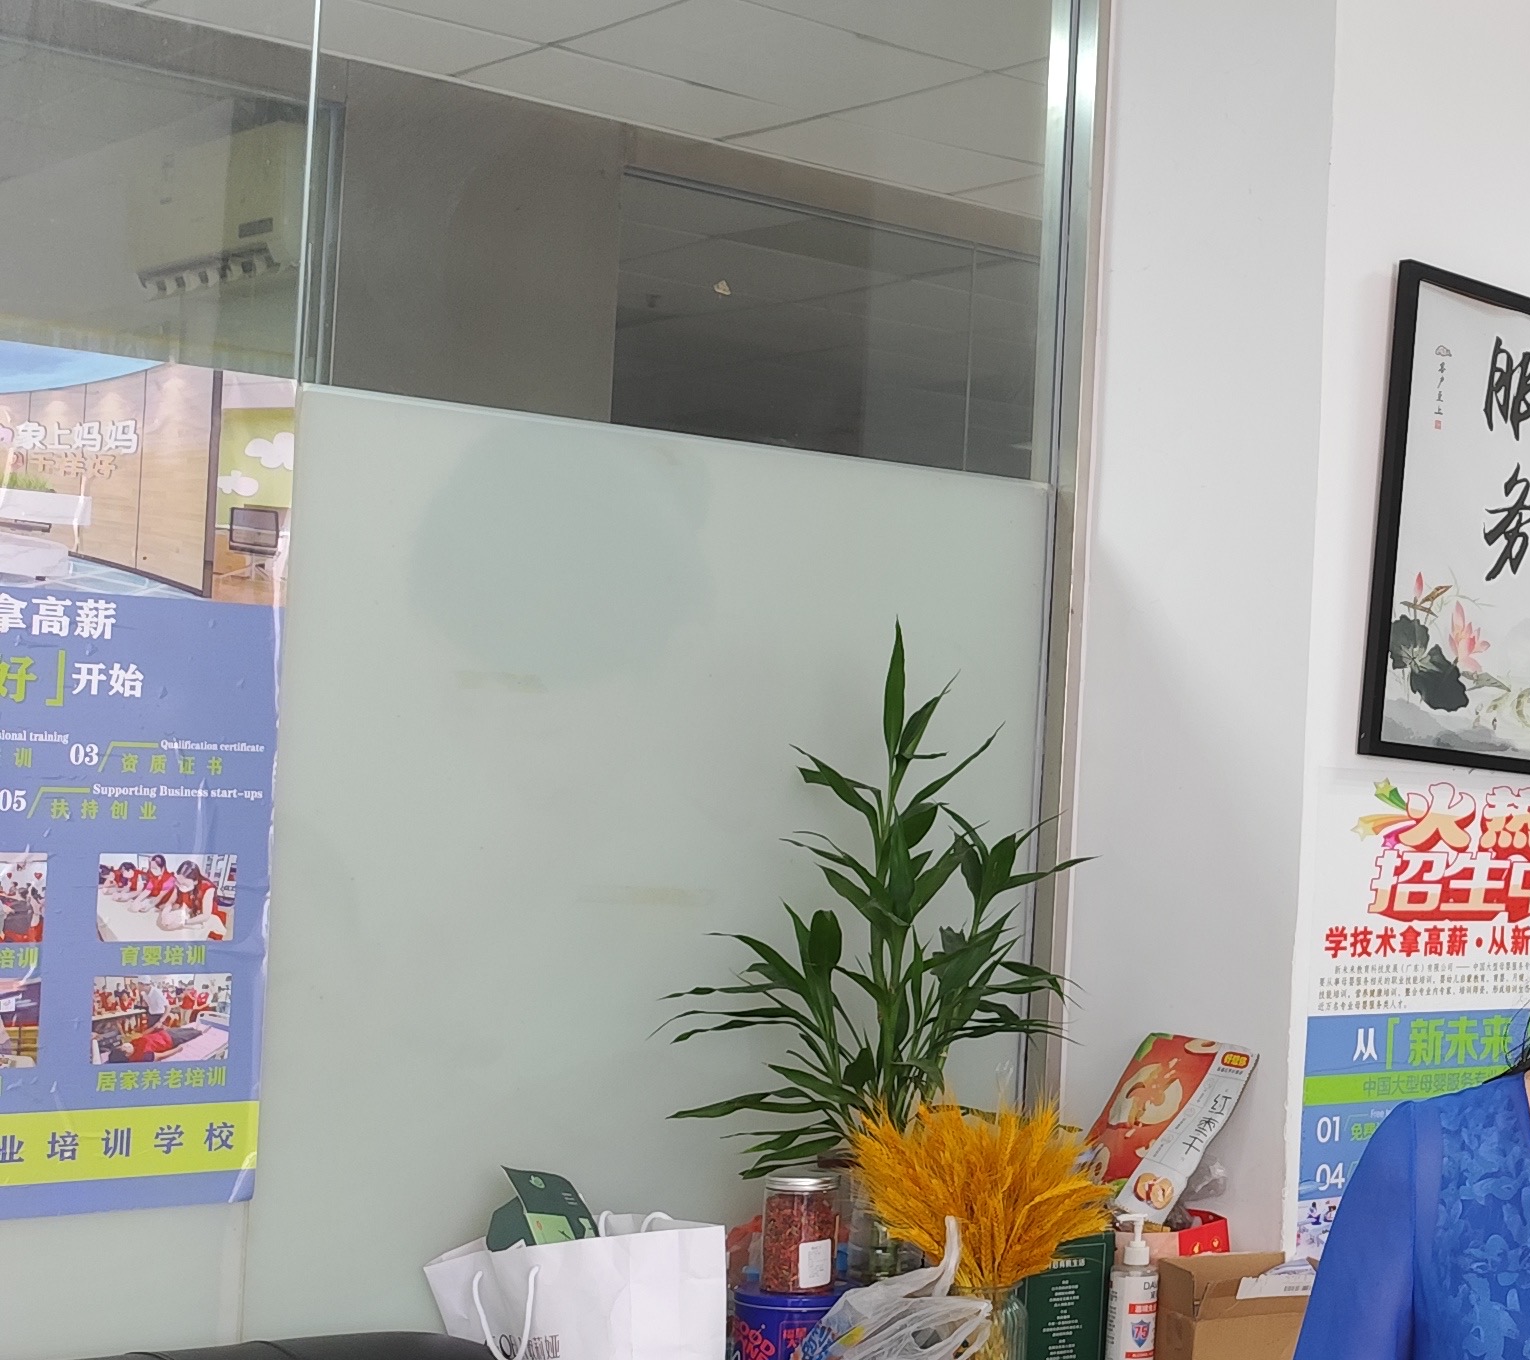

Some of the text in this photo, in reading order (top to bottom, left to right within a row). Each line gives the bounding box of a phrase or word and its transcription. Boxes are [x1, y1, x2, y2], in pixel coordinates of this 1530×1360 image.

[30, 731, 69, 744] training
[160, 739, 265, 752] Qualification certificate
[70, 743, 99, 766] 03
[121, 753, 223, 775] 资质证书
[0, 789, 27, 812] 05
[93, 783, 263, 800] Supporting Business start-ups
[51, 799, 157, 820] 扶持创业
[120, 944, 207, 967] 育婴培训
[96, 1066, 226, 1091] 居家养老培训
[1182, 1093, 1232, 1155] 红枣干
[1317, 1116, 1340, 1143] 01
[1316, 1162, 1345, 1191] 04
[1134, 1325, 1149, 1339] 75
